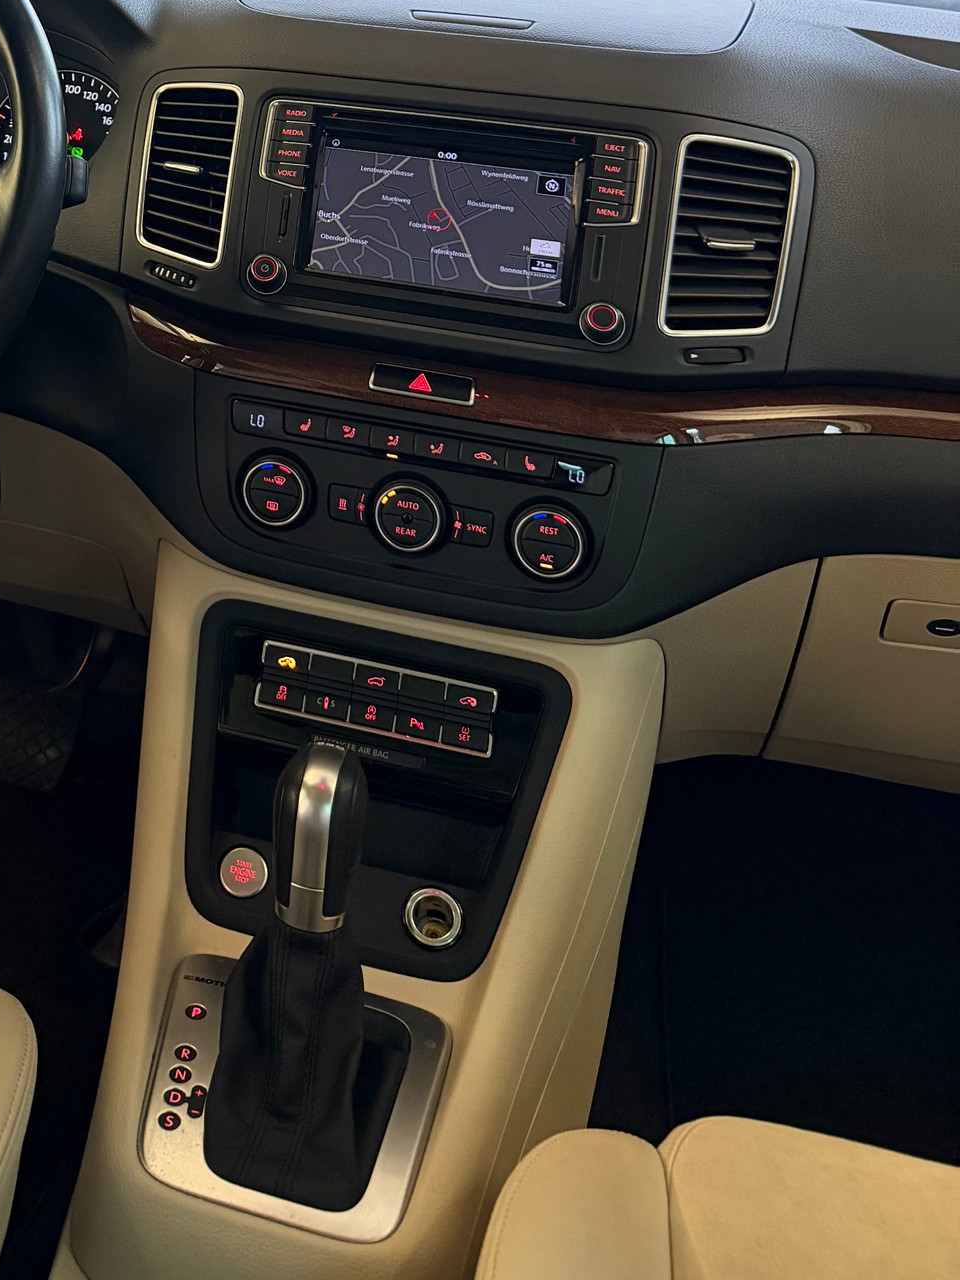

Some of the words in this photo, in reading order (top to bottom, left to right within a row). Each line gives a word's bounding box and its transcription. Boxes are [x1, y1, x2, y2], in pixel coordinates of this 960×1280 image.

[65, 84, 81, 95] 100
[83, 90, 99, 101] 120
[95, 102, 112, 113] 140
[286, 109, 307, 117] RADIO
[102, 116, 115, 126] 16
[282, 128, 304, 136] MEDIA
[604, 143, 626, 152] EJECT
[278, 149, 301, 158] PHONE
[437, 151, 458, 160] 0:00
[277, 169, 297, 178] VOICE
[604, 164, 621, 173] NAV
[481, 169, 529, 182] Wynenfeldweg
[598, 186, 626, 197] TRAFFIC
[318, 210, 341, 220] Buchs
[596, 208, 619, 217] MENU
[320, 233, 369, 246] Oberdorfstrasse
[430, 247, 472, 258] Fabrikstrasse
[249, 414, 265, 428] LO
[568, 469, 585, 484] LO
[396, 500, 420, 511] AUTO
[395, 526, 417, 538] REAR
[466, 523, 488, 535] SYNC
[539, 525, 559, 536] REST
[540, 553, 554, 563] A/C
[275, 693, 287, 701] OFF
[364, 713, 376, 721] OFF
[458, 734, 470, 742] SET
[357, 745, 371, 755] AIR
[372, 749, 389, 759] BAG
[235, 859, 252, 869] START
[229, 865, 256, 879] ENGINE
[234, 874, 249, 883] STOP
[184, 975, 227, 987] MOTI
[191, 1007, 202, 1017] P
[180, 1048, 191, 1059] R
[174, 1069, 187, 1081] N
[169, 1092, 182, 1104] D
[164, 1115, 174, 1128] S
